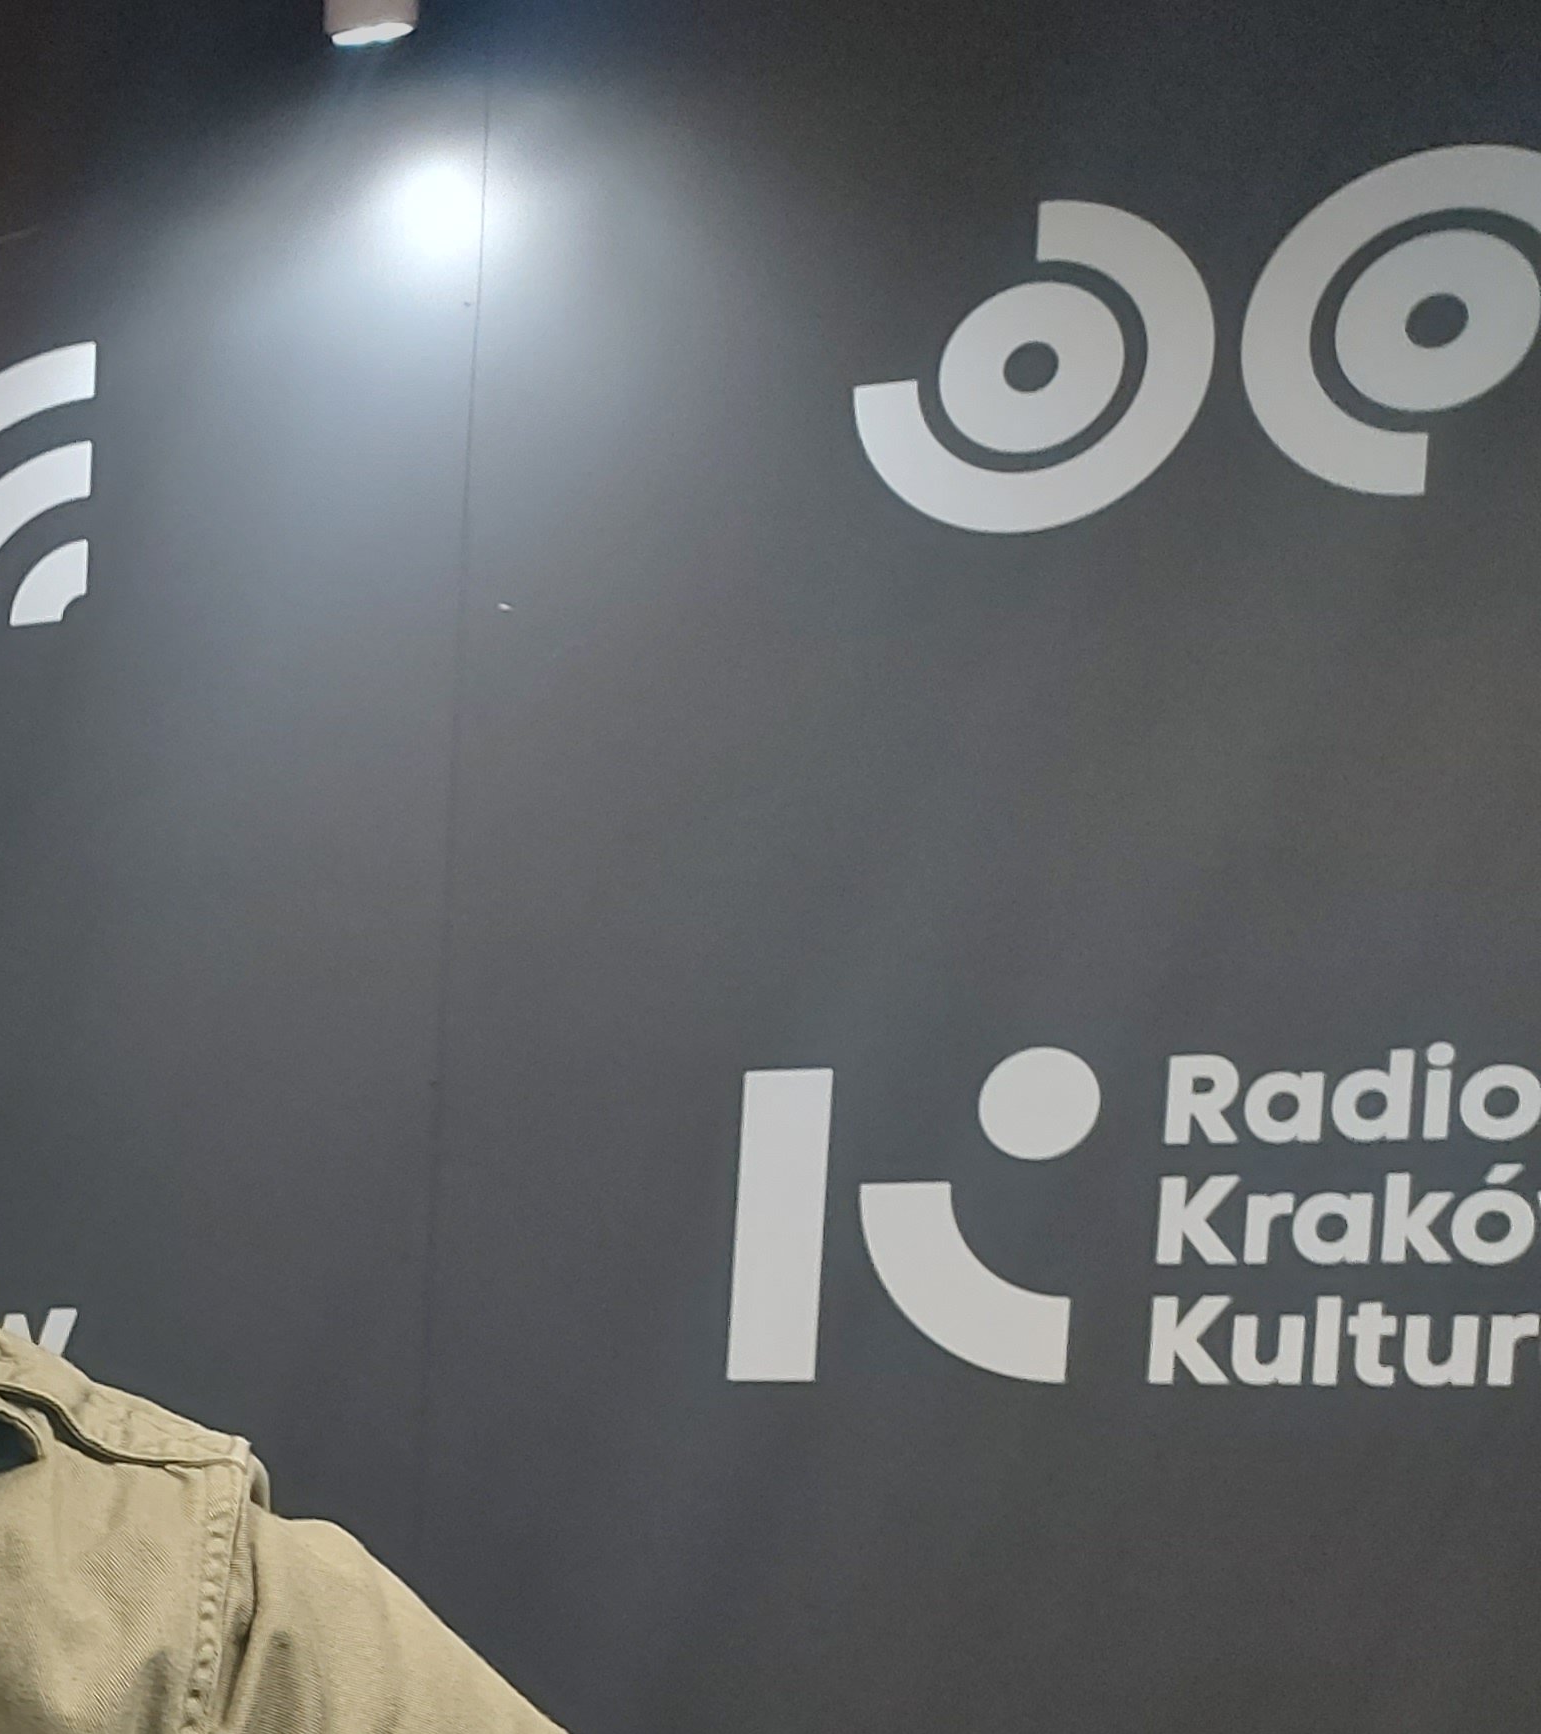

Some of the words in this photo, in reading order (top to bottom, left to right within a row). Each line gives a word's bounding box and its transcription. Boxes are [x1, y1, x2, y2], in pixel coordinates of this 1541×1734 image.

[1163, 1040, 1541, 1145] Radio
[1153, 1163, 1541, 1266] Krakó
[1146, 1294, 1541, 1387] Kultur
